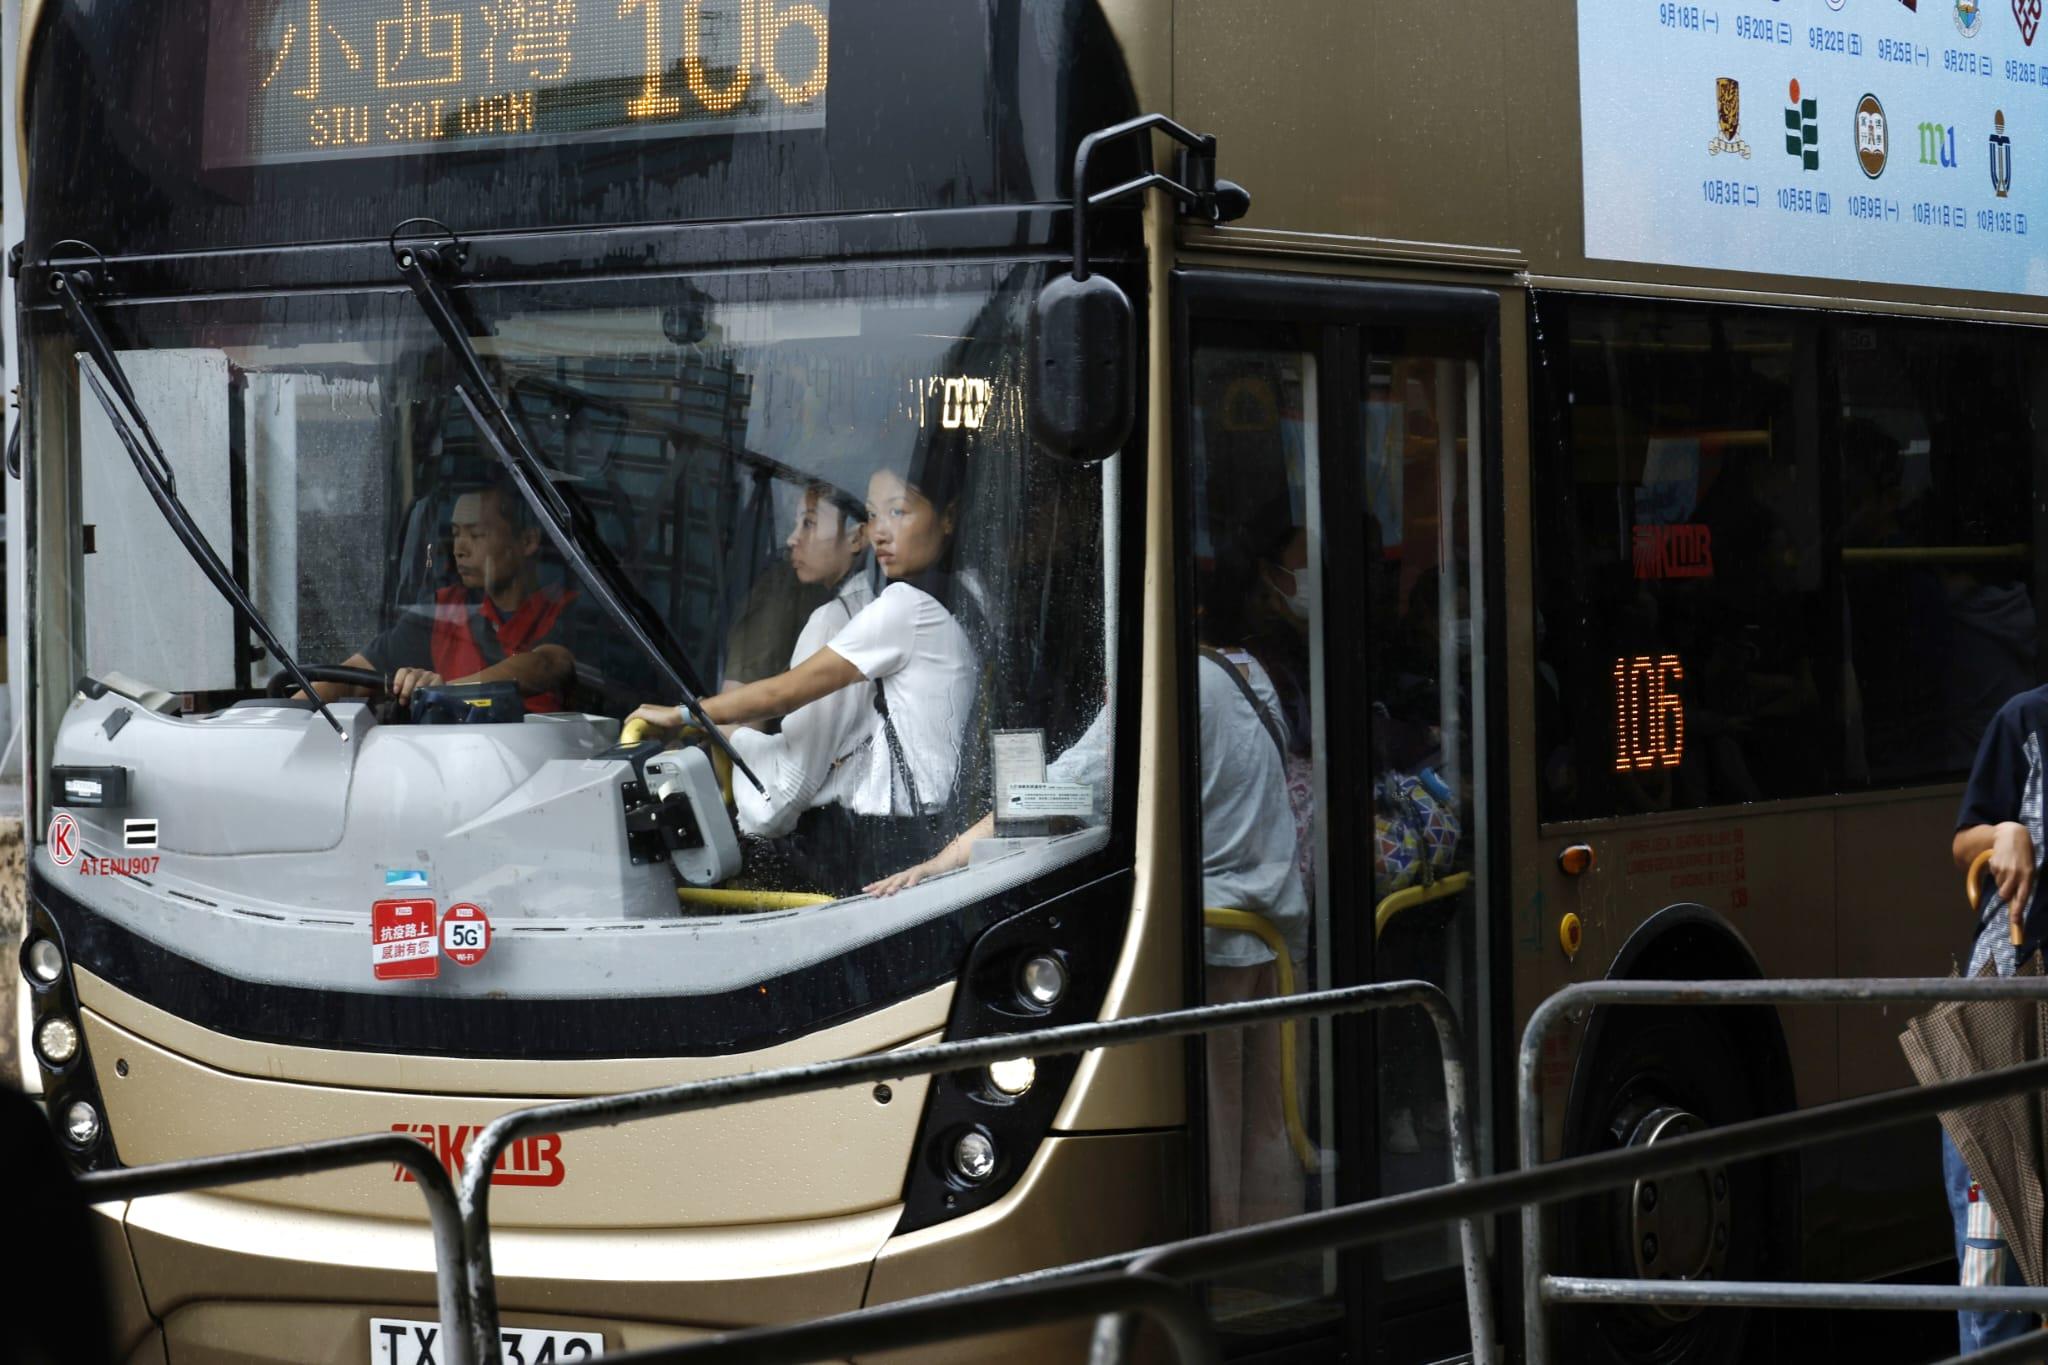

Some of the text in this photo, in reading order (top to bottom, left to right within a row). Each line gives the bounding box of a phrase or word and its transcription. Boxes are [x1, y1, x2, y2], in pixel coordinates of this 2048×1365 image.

[261, 0, 576, 100] 小西灣
[617, 0, 829, 117] 106
[309, 91, 534, 146] SIU SAI WAN
[1655, 523, 1713, 577] KMB
[1613, 654, 1684, 771] 106
[80, 857, 160, 876] ATENU907
[380, 921, 430, 942] 抗疫路上
[381, 940, 430, 960] 感謝有您
[453, 924, 478, 946] 5G
[380, 1325, 438, 1365] TX
